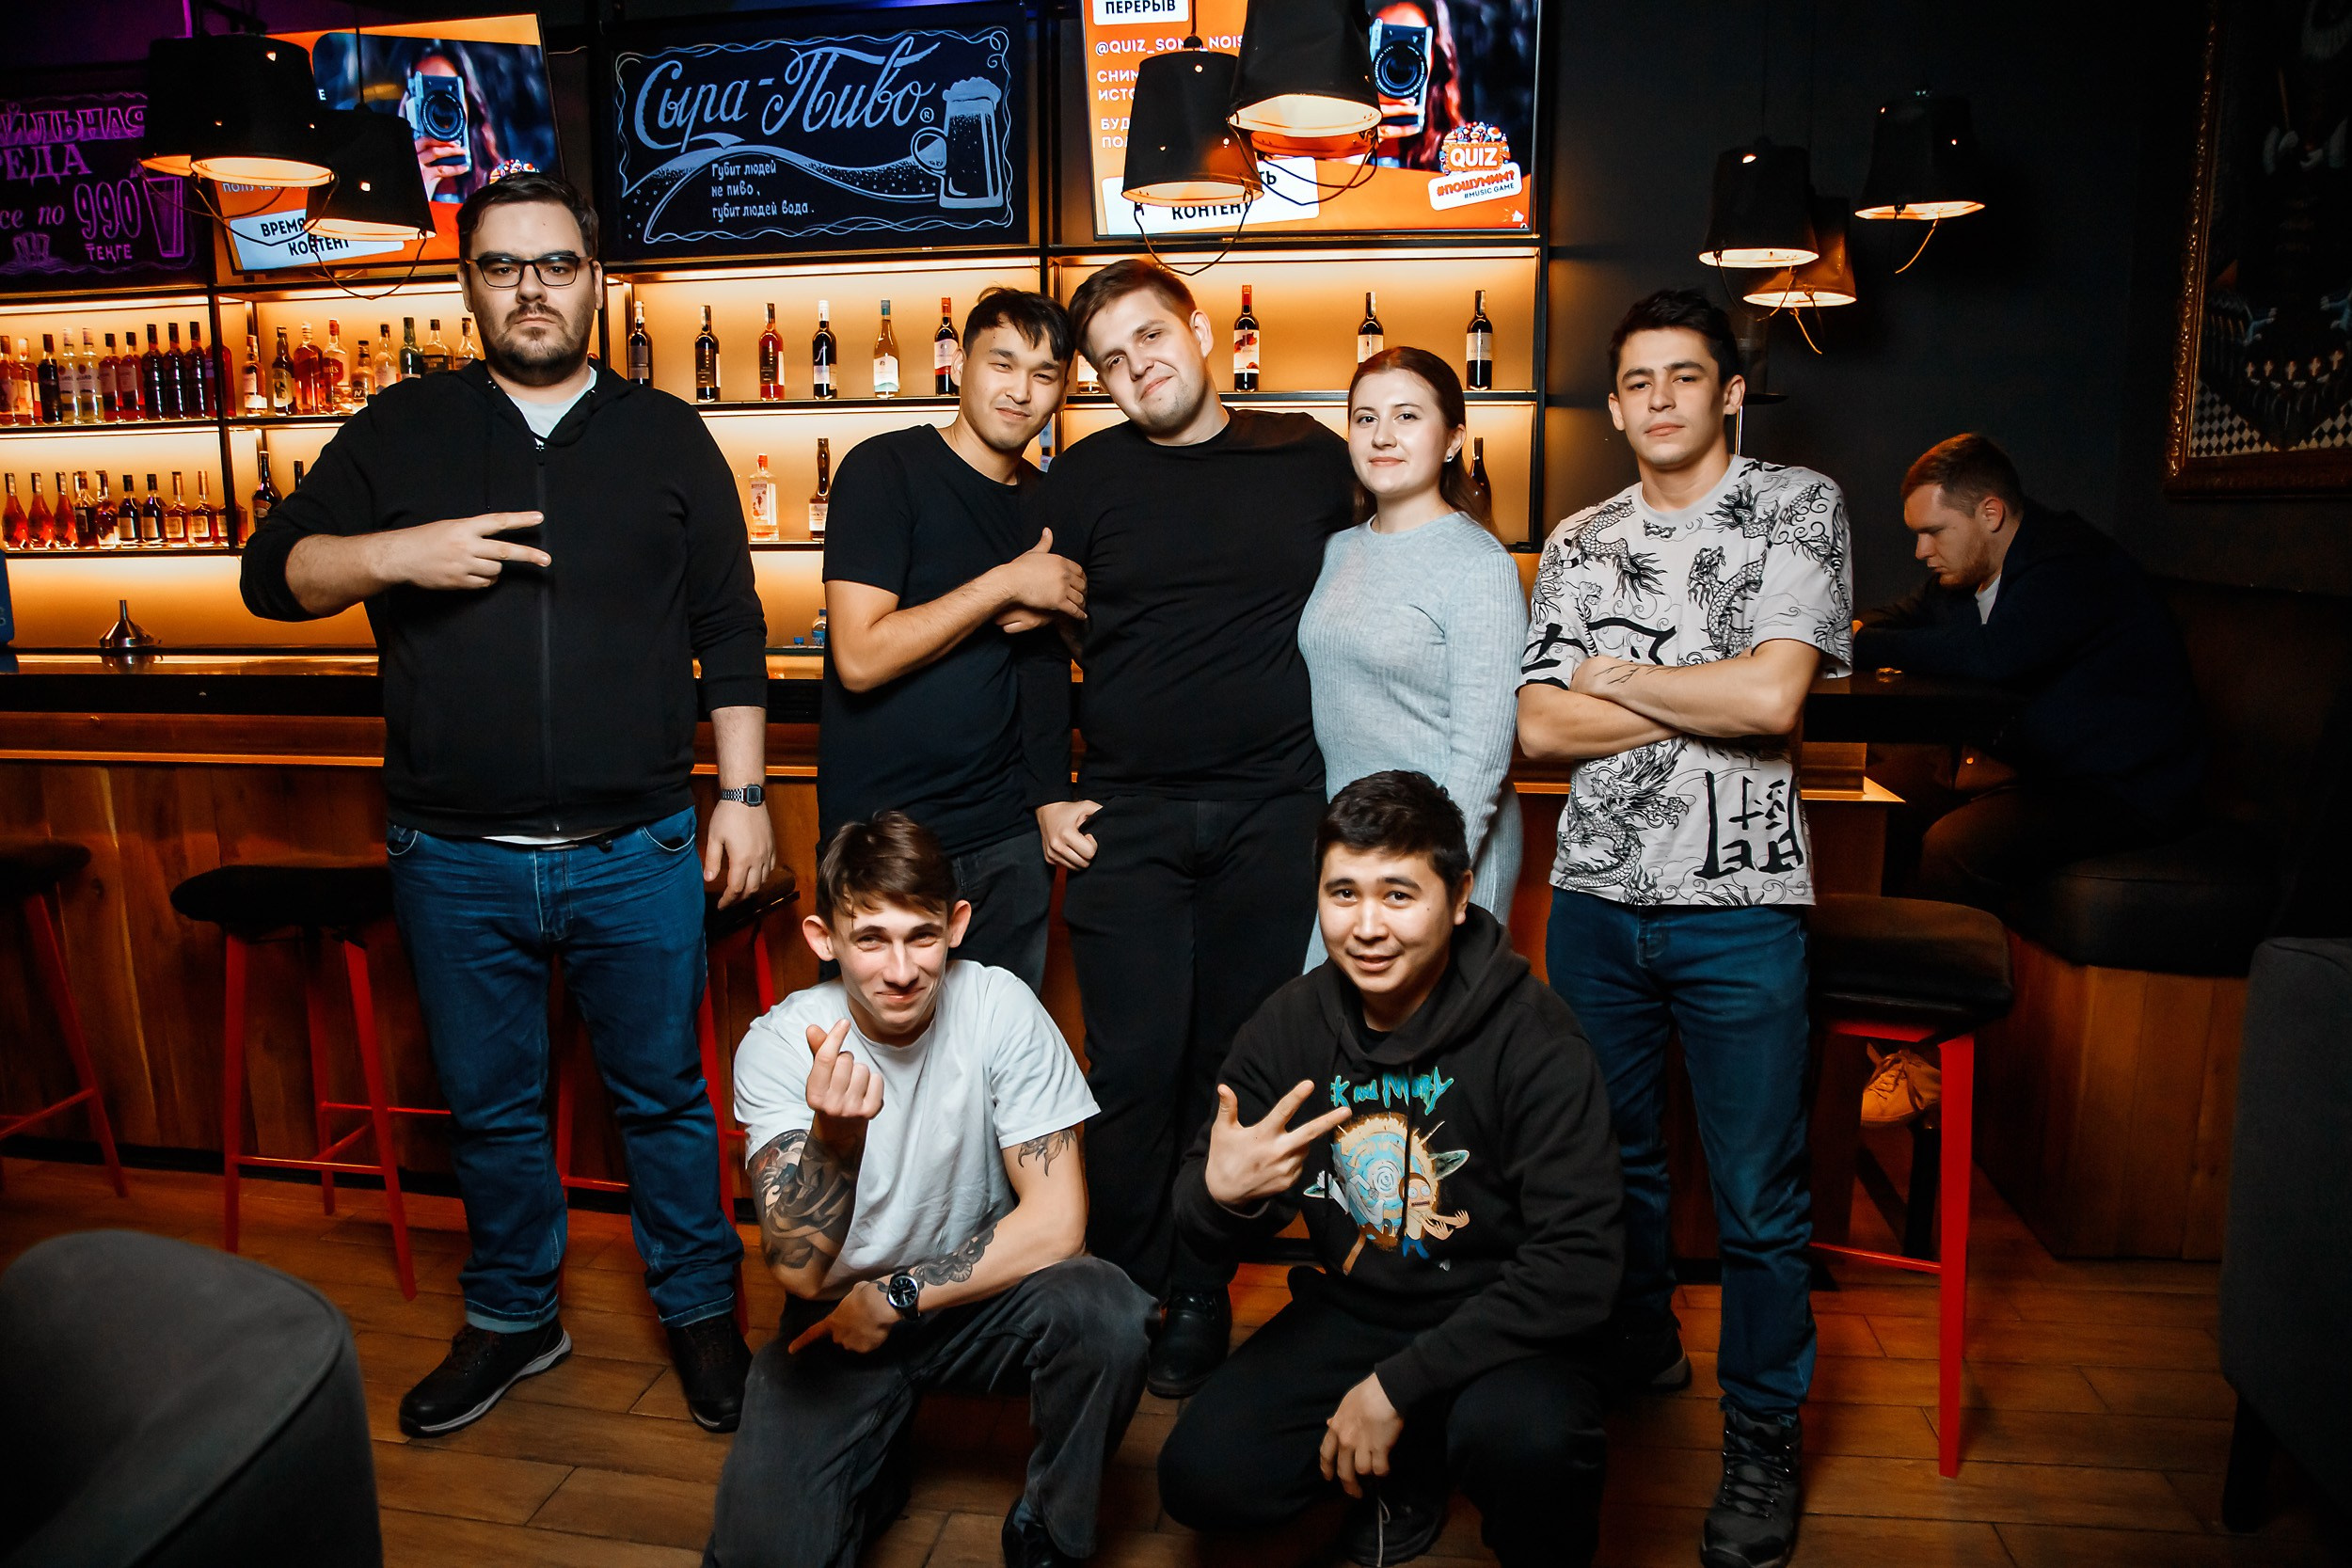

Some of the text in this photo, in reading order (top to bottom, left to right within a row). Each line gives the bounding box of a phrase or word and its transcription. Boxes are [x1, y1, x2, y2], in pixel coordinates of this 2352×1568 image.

[1105, 0, 1176, 14] ПЕРЕРЫВ
[0, 143, 92, 186] ЕДА
[1450, 147, 1498, 167] QUIZ
[711, 160, 776, 181] Губит людей
[711, 185, 723, 198] не
[1464, 182, 1515, 198] #MUSIC GAME
[39, 205, 65, 226] по
[74, 179, 141, 239] 990
[712, 202, 740, 223] губит
[742, 201, 778, 217] людей
